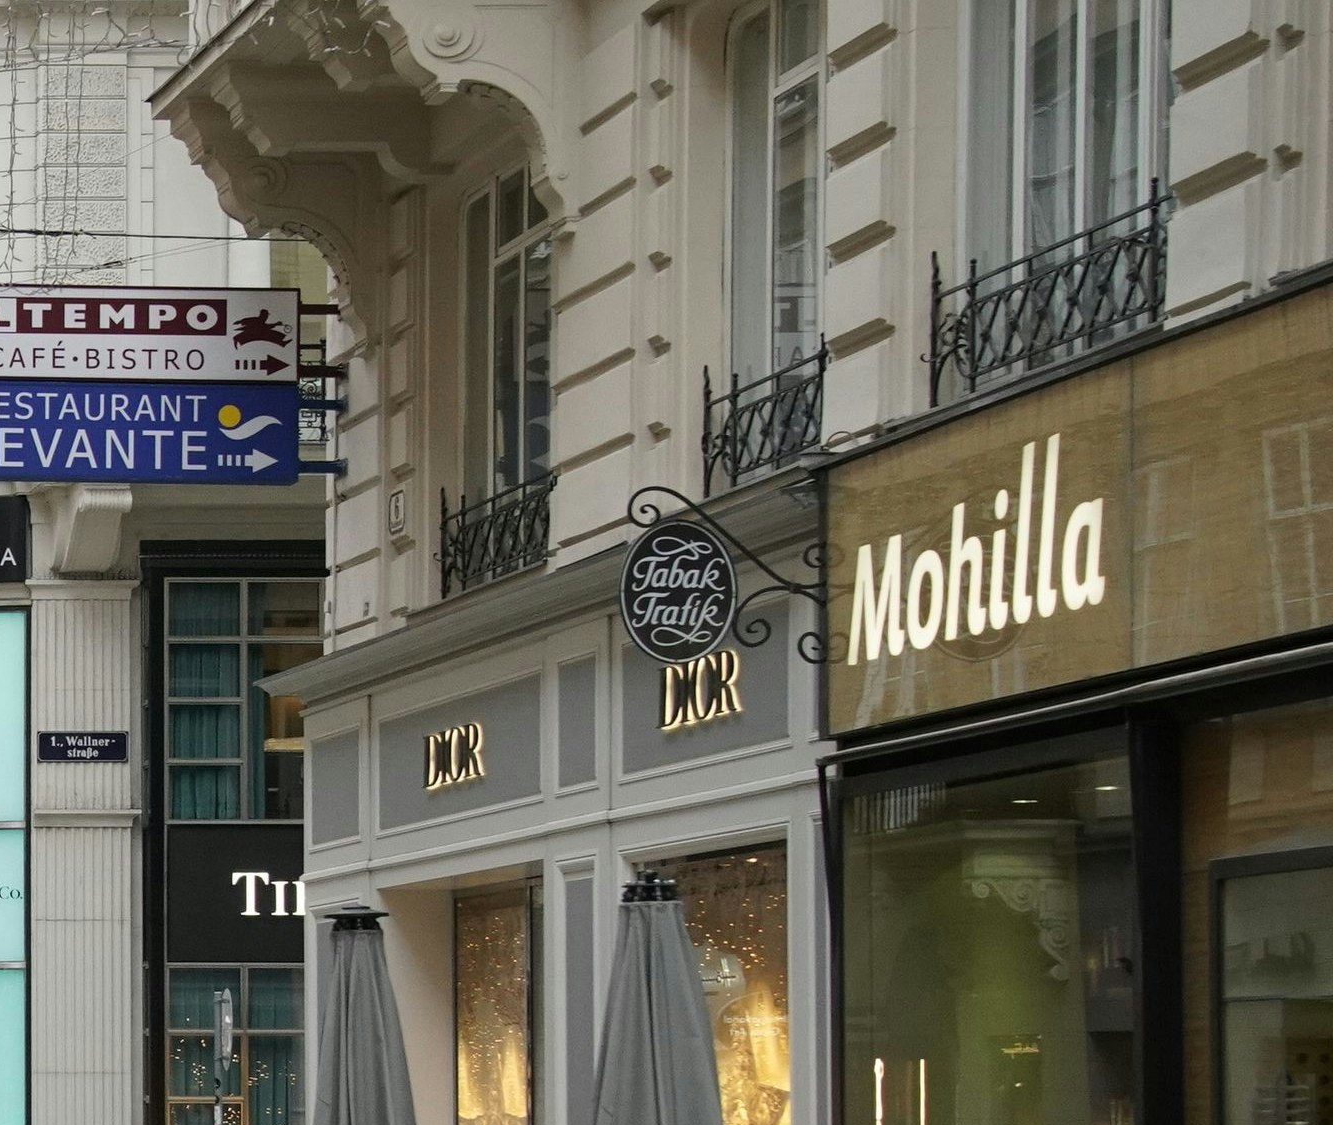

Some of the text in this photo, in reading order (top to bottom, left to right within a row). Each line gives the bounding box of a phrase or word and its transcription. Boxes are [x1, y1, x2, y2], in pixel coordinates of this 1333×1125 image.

[23, 303, 219, 331] TEMPO
[847, 432, 1106, 666] Mohilla
[632, 555, 726, 592] Tabak
[632, 592, 725, 628] Trafik
[66, 736, 116, 747] Wallner-
[67, 748, 99, 759] straße
